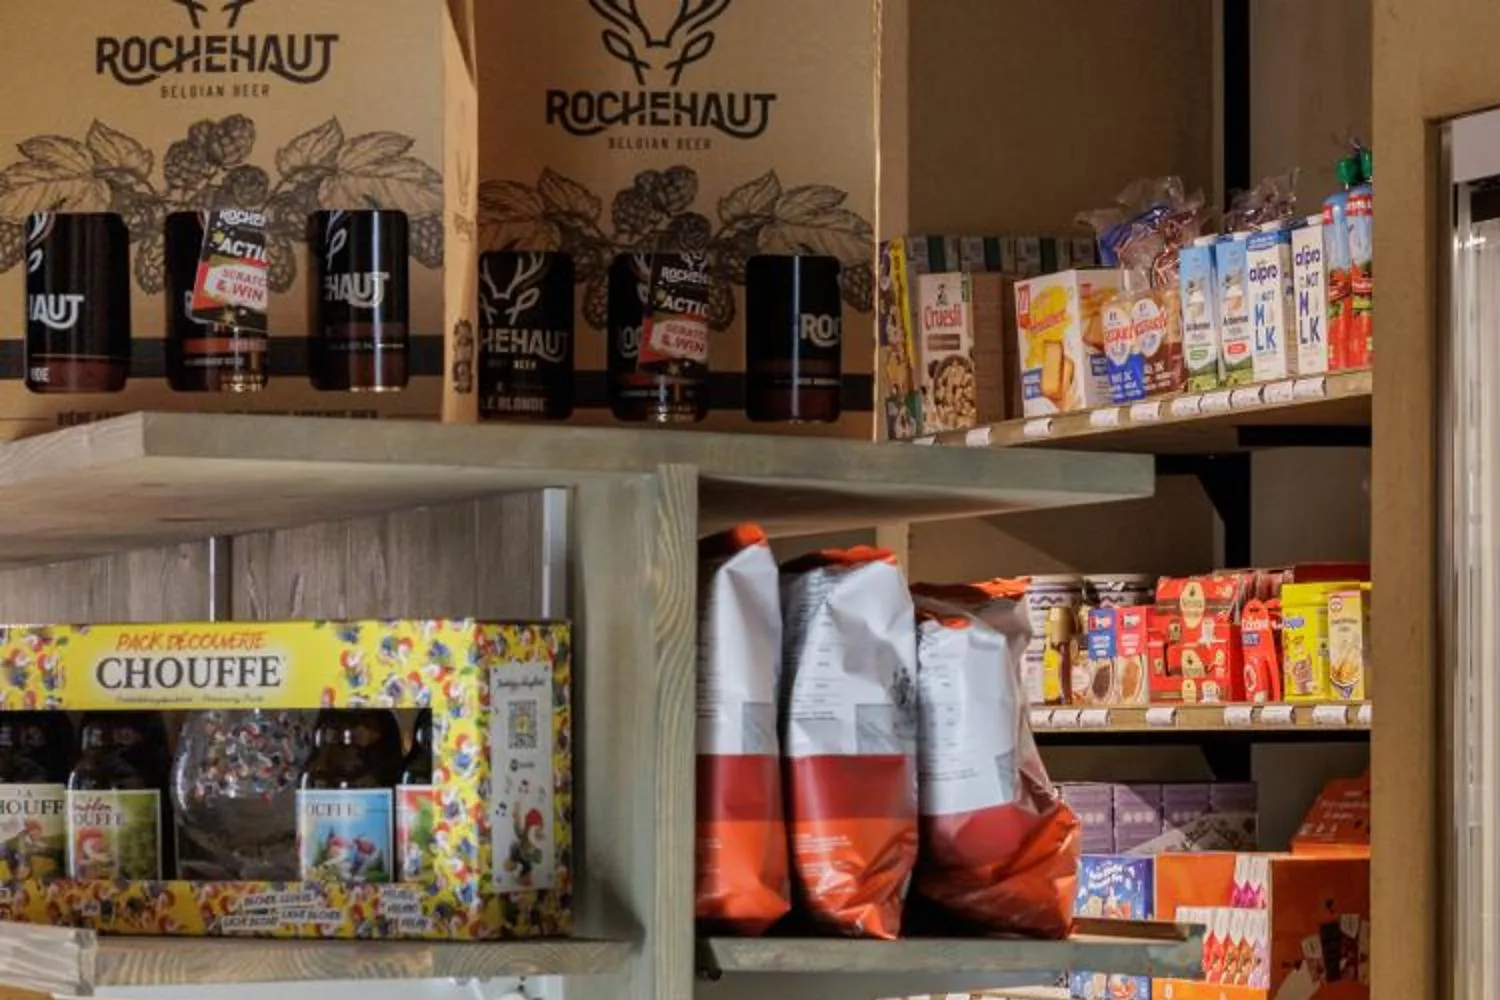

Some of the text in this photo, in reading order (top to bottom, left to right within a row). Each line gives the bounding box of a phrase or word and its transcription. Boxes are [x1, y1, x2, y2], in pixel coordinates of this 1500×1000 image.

[96, 33, 339, 86] ROCHEHAUT
[160, 83, 270, 99] BELGIAN BEER
[546, 90, 776, 139] ROCHEHAUT
[608, 137, 711, 151] BELGIAN BEER
[115, 631, 163, 651] PACK
[96, 654, 282, 689] CHOUFFE
